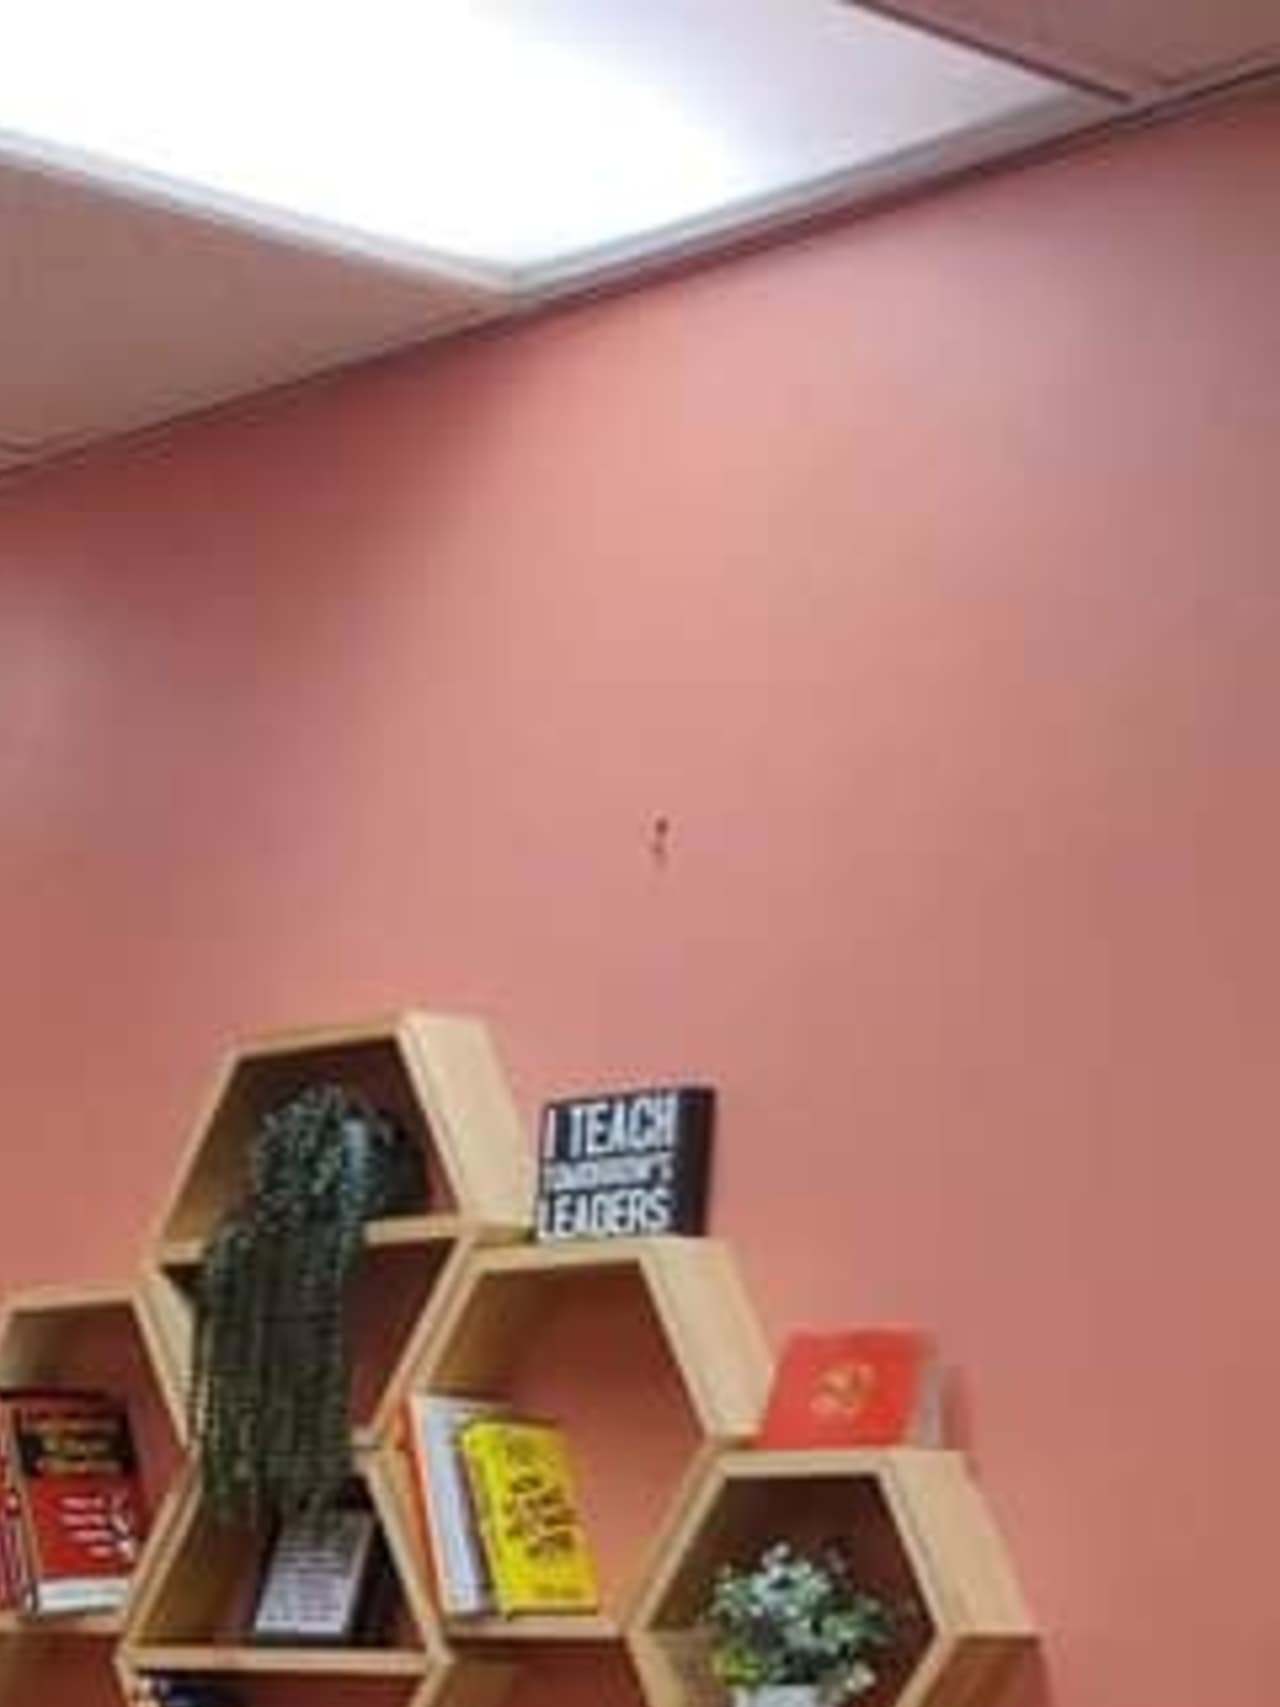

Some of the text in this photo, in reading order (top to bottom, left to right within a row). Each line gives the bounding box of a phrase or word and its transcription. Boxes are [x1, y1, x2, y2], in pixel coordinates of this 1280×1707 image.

[544, 1096, 678, 1159] I TEACH
[537, 1187, 673, 1239] LEADERS
